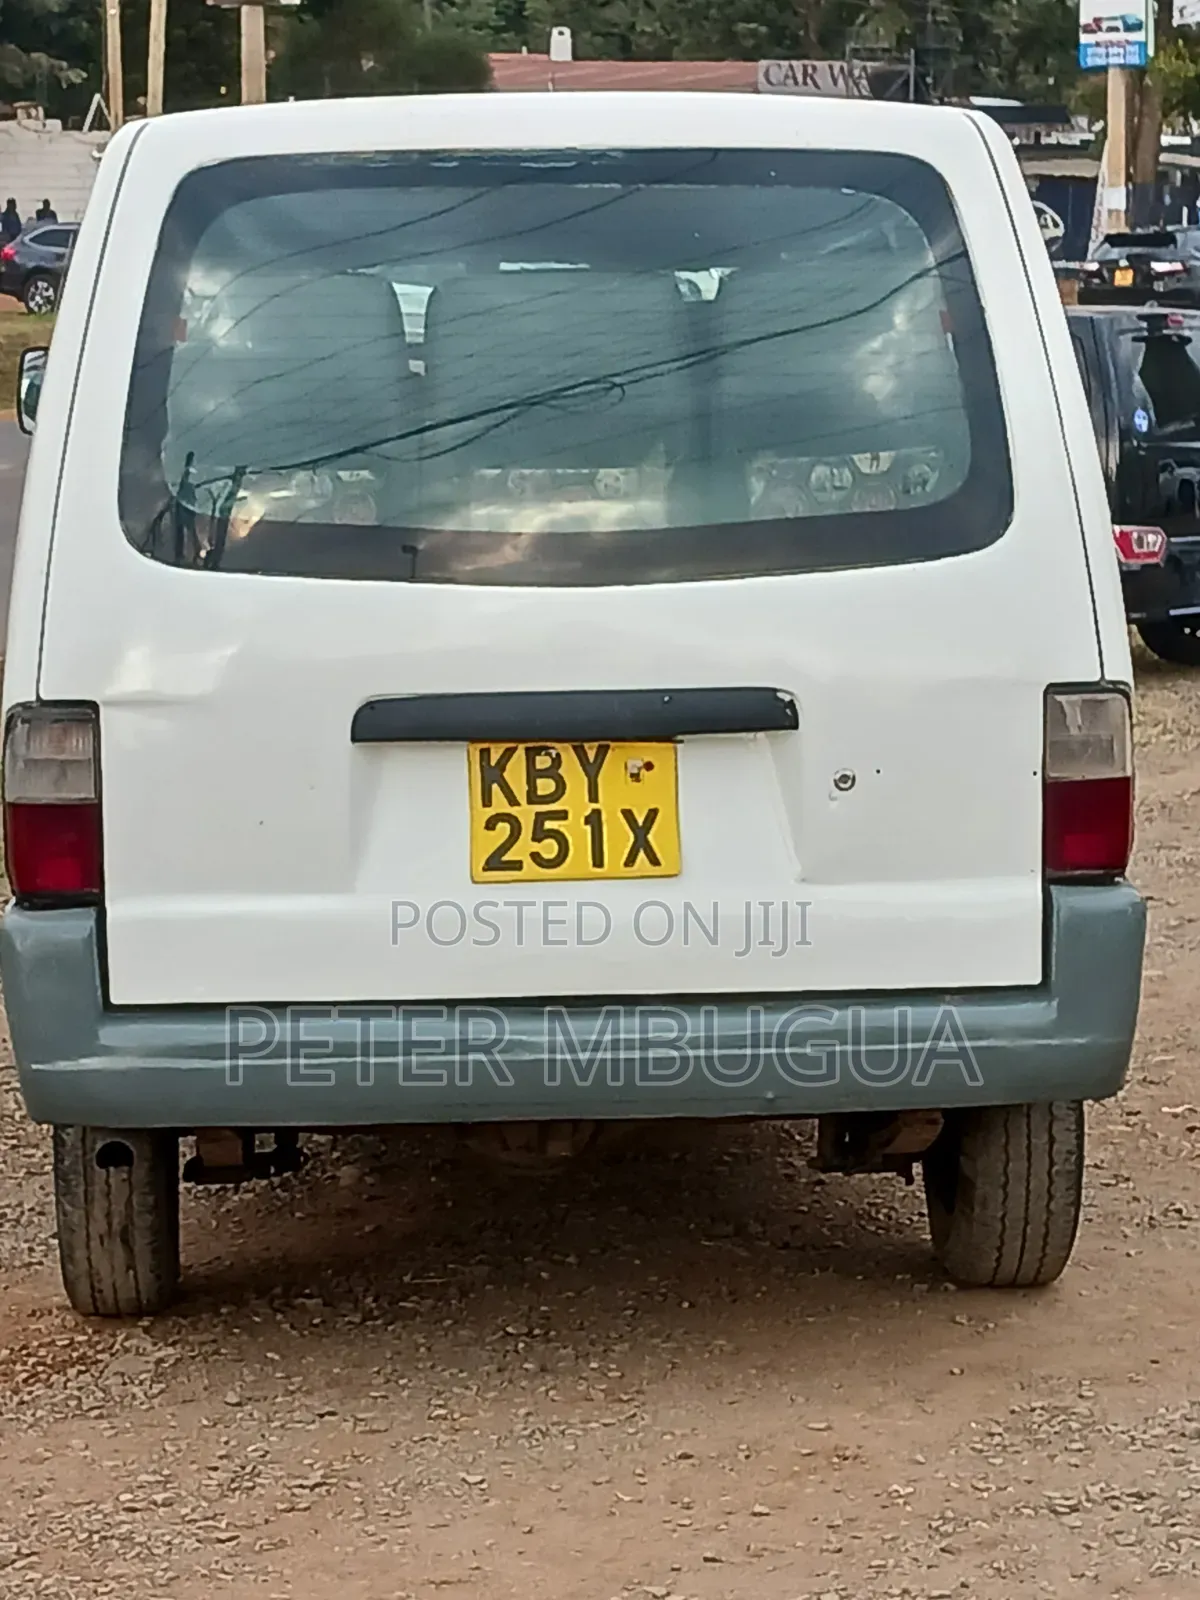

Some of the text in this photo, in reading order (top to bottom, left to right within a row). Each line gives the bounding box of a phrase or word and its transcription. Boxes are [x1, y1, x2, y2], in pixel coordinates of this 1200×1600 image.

[763, 63, 820, 90] CAR
[479, 744, 610, 808] KBY
[482, 807, 662, 872] 251X
